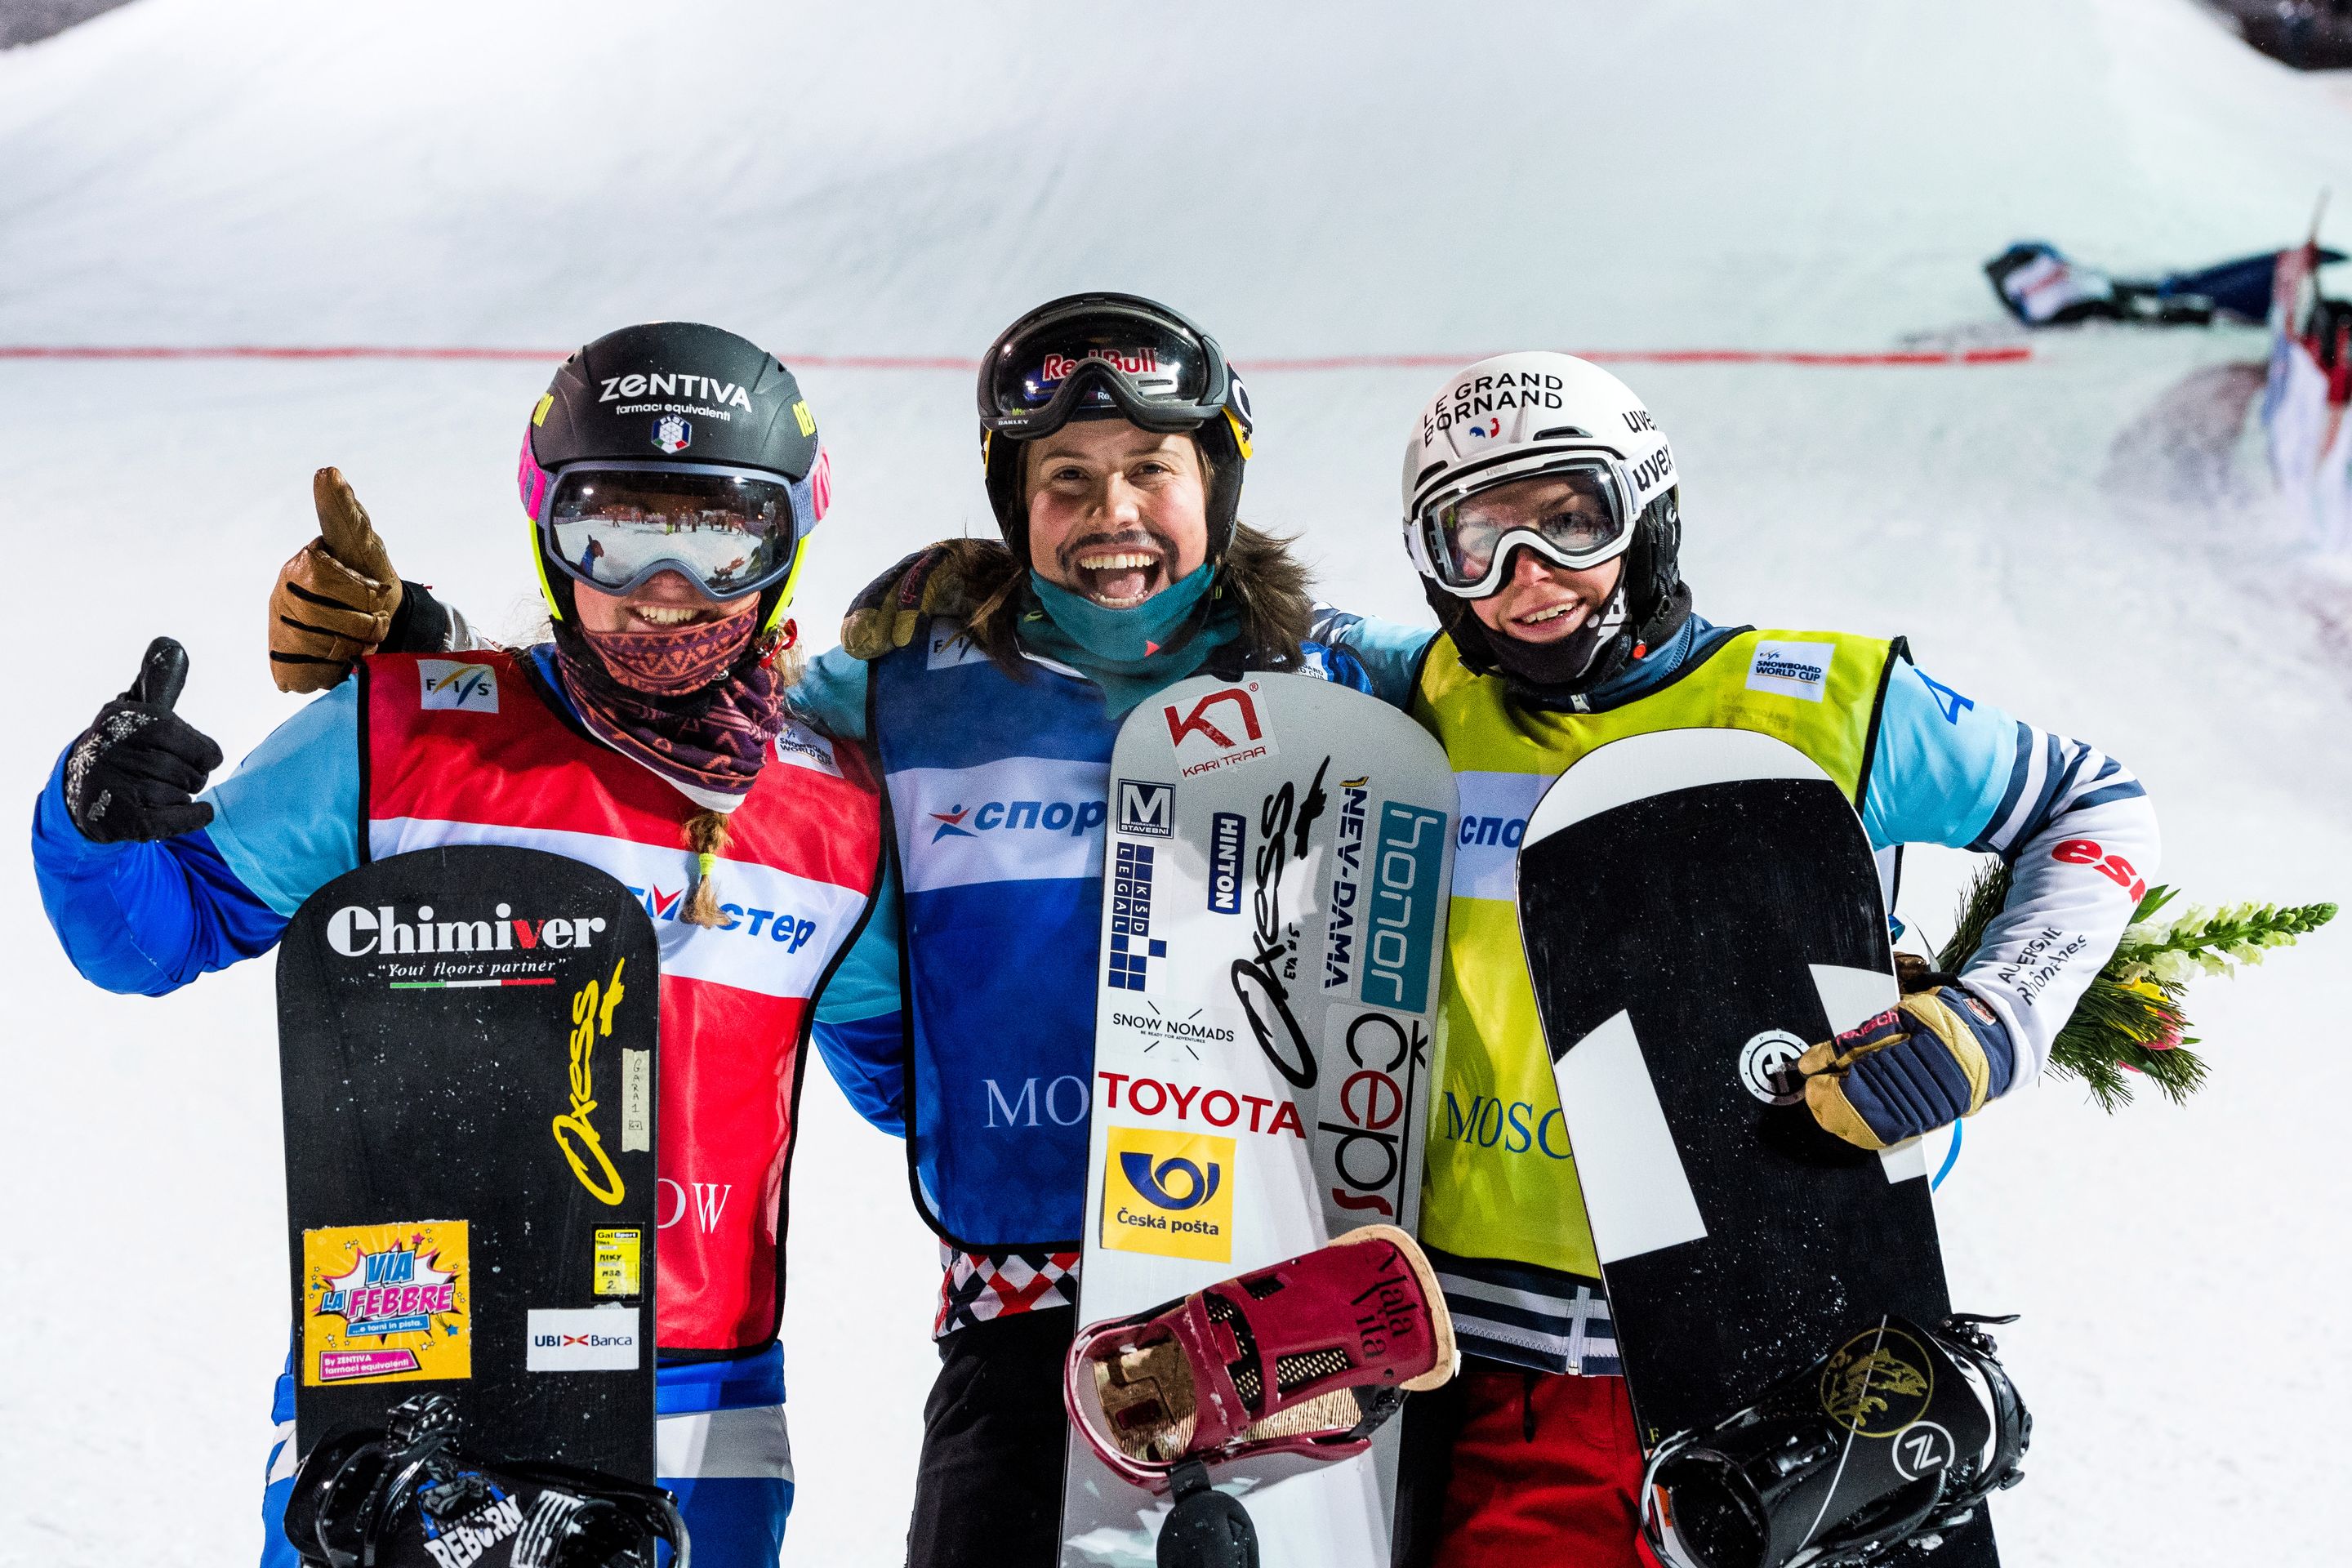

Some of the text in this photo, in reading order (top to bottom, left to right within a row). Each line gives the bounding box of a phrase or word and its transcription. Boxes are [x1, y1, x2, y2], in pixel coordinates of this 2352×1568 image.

[1102, 348, 1156, 374] Bull
[617, 403, 730, 421] farmaci equivalenti
[1424, 372, 1563, 429] LE GRAND
[1425, 390, 1563, 448] BORNAND
[1633, 444, 1674, 492] uvex
[1755, 666, 1820, 681] WORLD CUP
[1757, 660, 1822, 674] SNOWBOARD
[1183, 746, 1267, 777] KARI TRAA
[1215, 817, 1239, 910] HINTON
[1115, 848, 1130, 929] LEGAL
[1134, 886, 1148, 932] KŠD
[327, 903, 606, 957] Chimiver
[434, 961, 483, 978] floors
[1113, 1013, 1234, 1042] SNOW NOMADS
[1176, 1036, 1205, 1044] ADVENTURES
[1098, 1071, 1307, 1139] TOYOTA
[1116, 1207, 1219, 1236] Česká pošta
[366, 1250, 415, 1285] VIA
[321, 1283, 454, 1319] LA FEBBRE
[368, 1323, 387, 1332] torni
[535, 1334, 632, 1347] UBI Banca
[324, 1354, 372, 1367] By ZENTIVA
[324, 1358, 409, 1375] farmaci equivalenti
